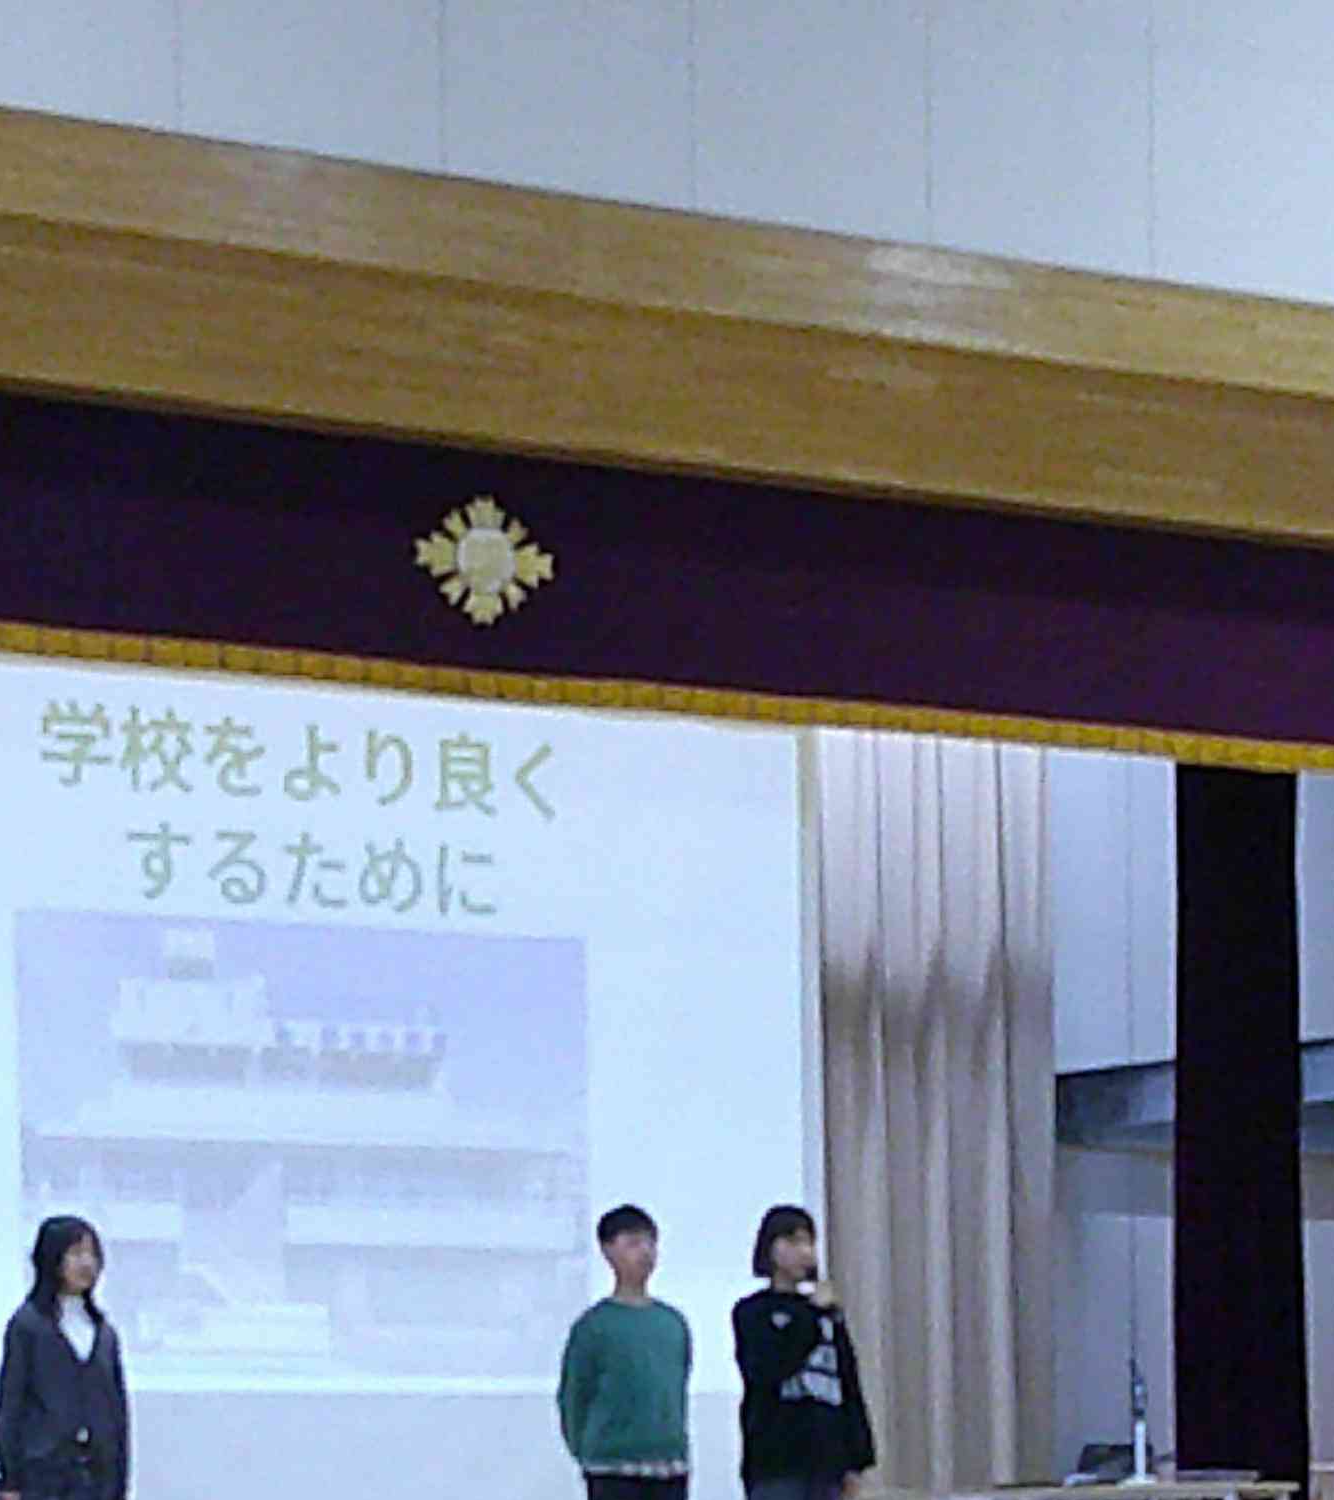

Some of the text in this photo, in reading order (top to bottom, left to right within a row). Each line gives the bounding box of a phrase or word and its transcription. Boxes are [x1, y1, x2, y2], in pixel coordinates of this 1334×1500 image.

[40, 701, 556, 821] 学校をより良く
[126, 822, 498, 915] するために
